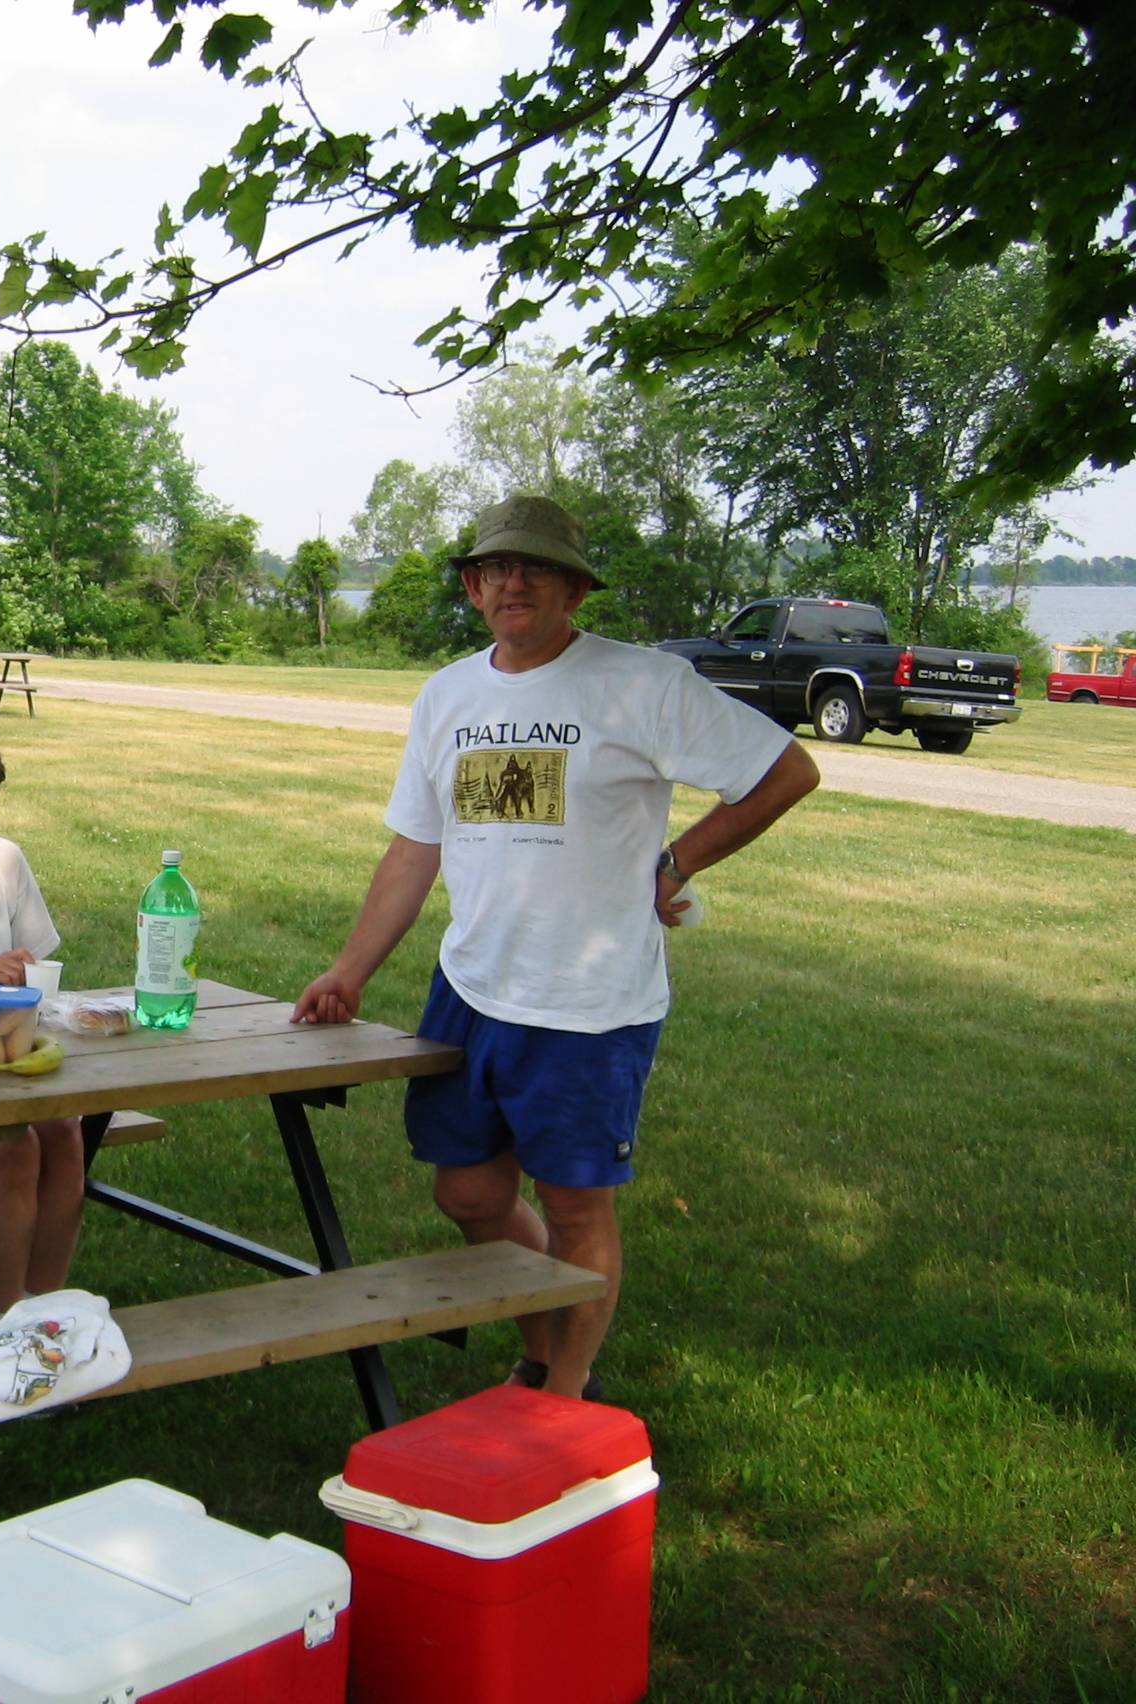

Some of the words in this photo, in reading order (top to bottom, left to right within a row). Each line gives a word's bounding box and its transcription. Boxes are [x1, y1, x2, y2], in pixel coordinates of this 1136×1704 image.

[918, 670, 1008, 685] CHEVROLET
[455, 723, 581, 749] THAILAND
[548, 803, 556, 815] 2
